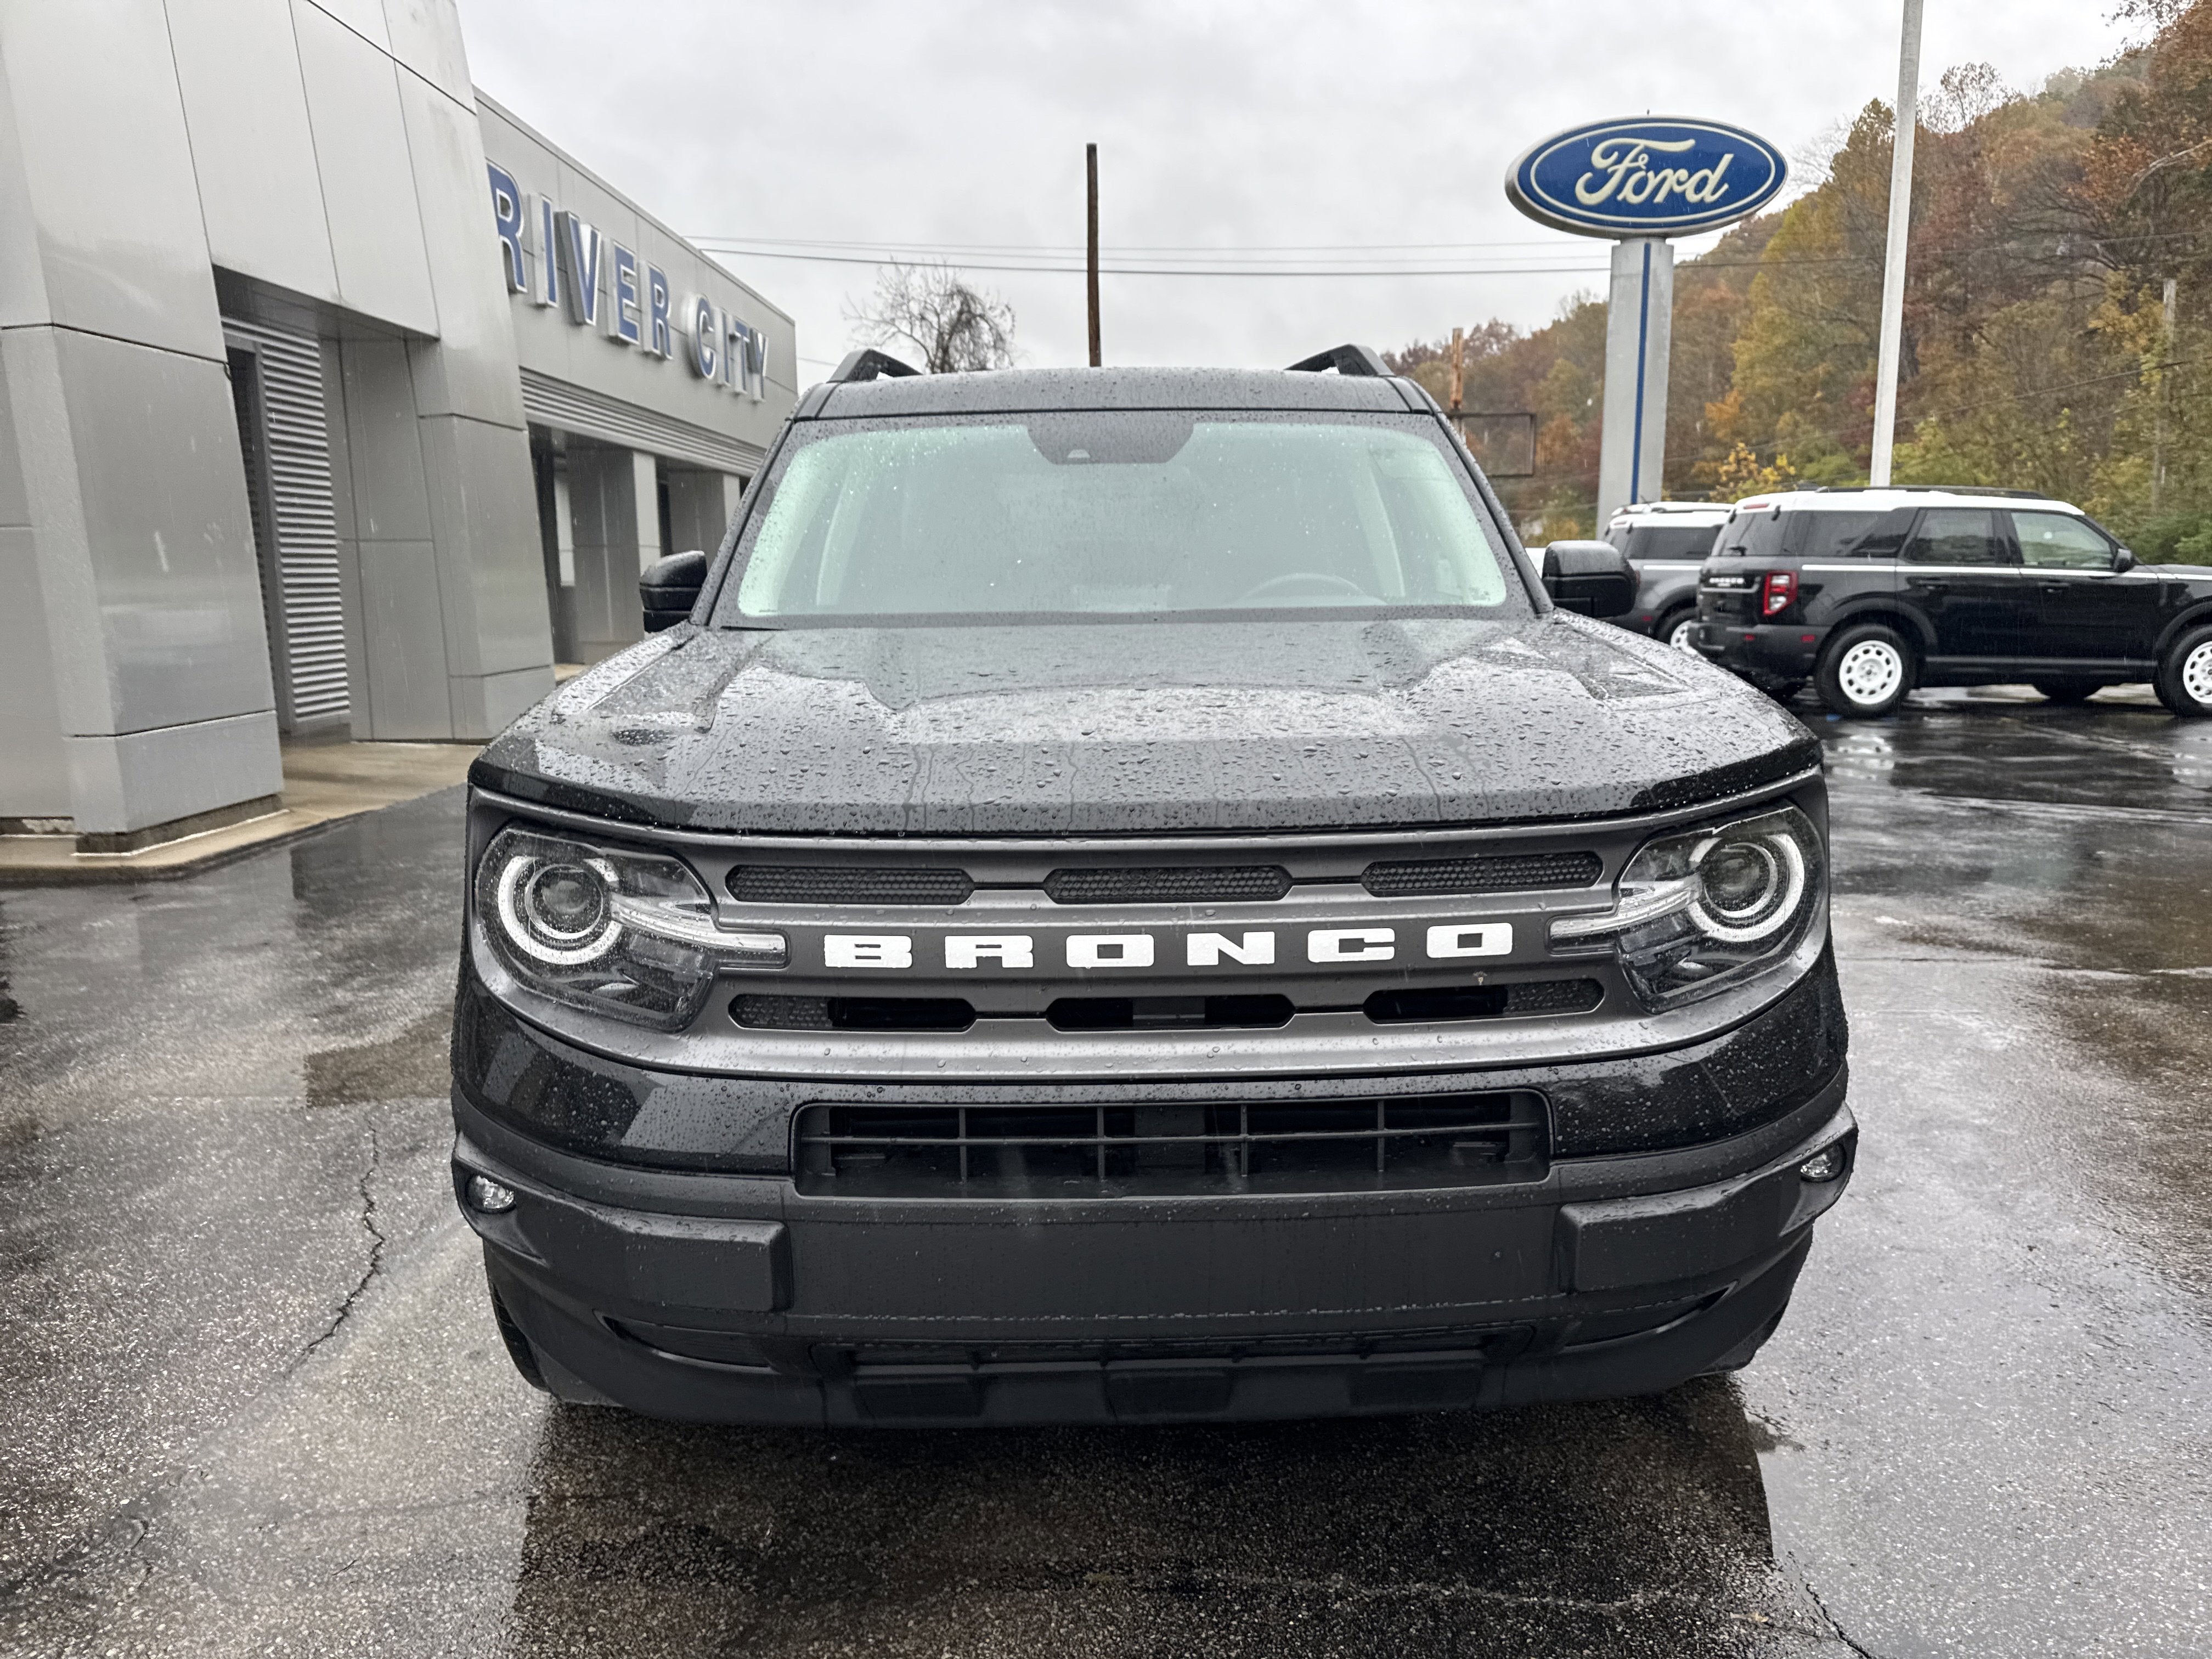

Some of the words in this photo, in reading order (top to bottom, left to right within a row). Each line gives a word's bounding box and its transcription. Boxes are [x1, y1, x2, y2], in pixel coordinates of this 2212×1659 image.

[1575, 137, 1734, 205] Ford
[486, 157, 673, 360] RIVER
[684, 293, 768, 403] CITY
[824, 923, 1513, 969] BRONCO
